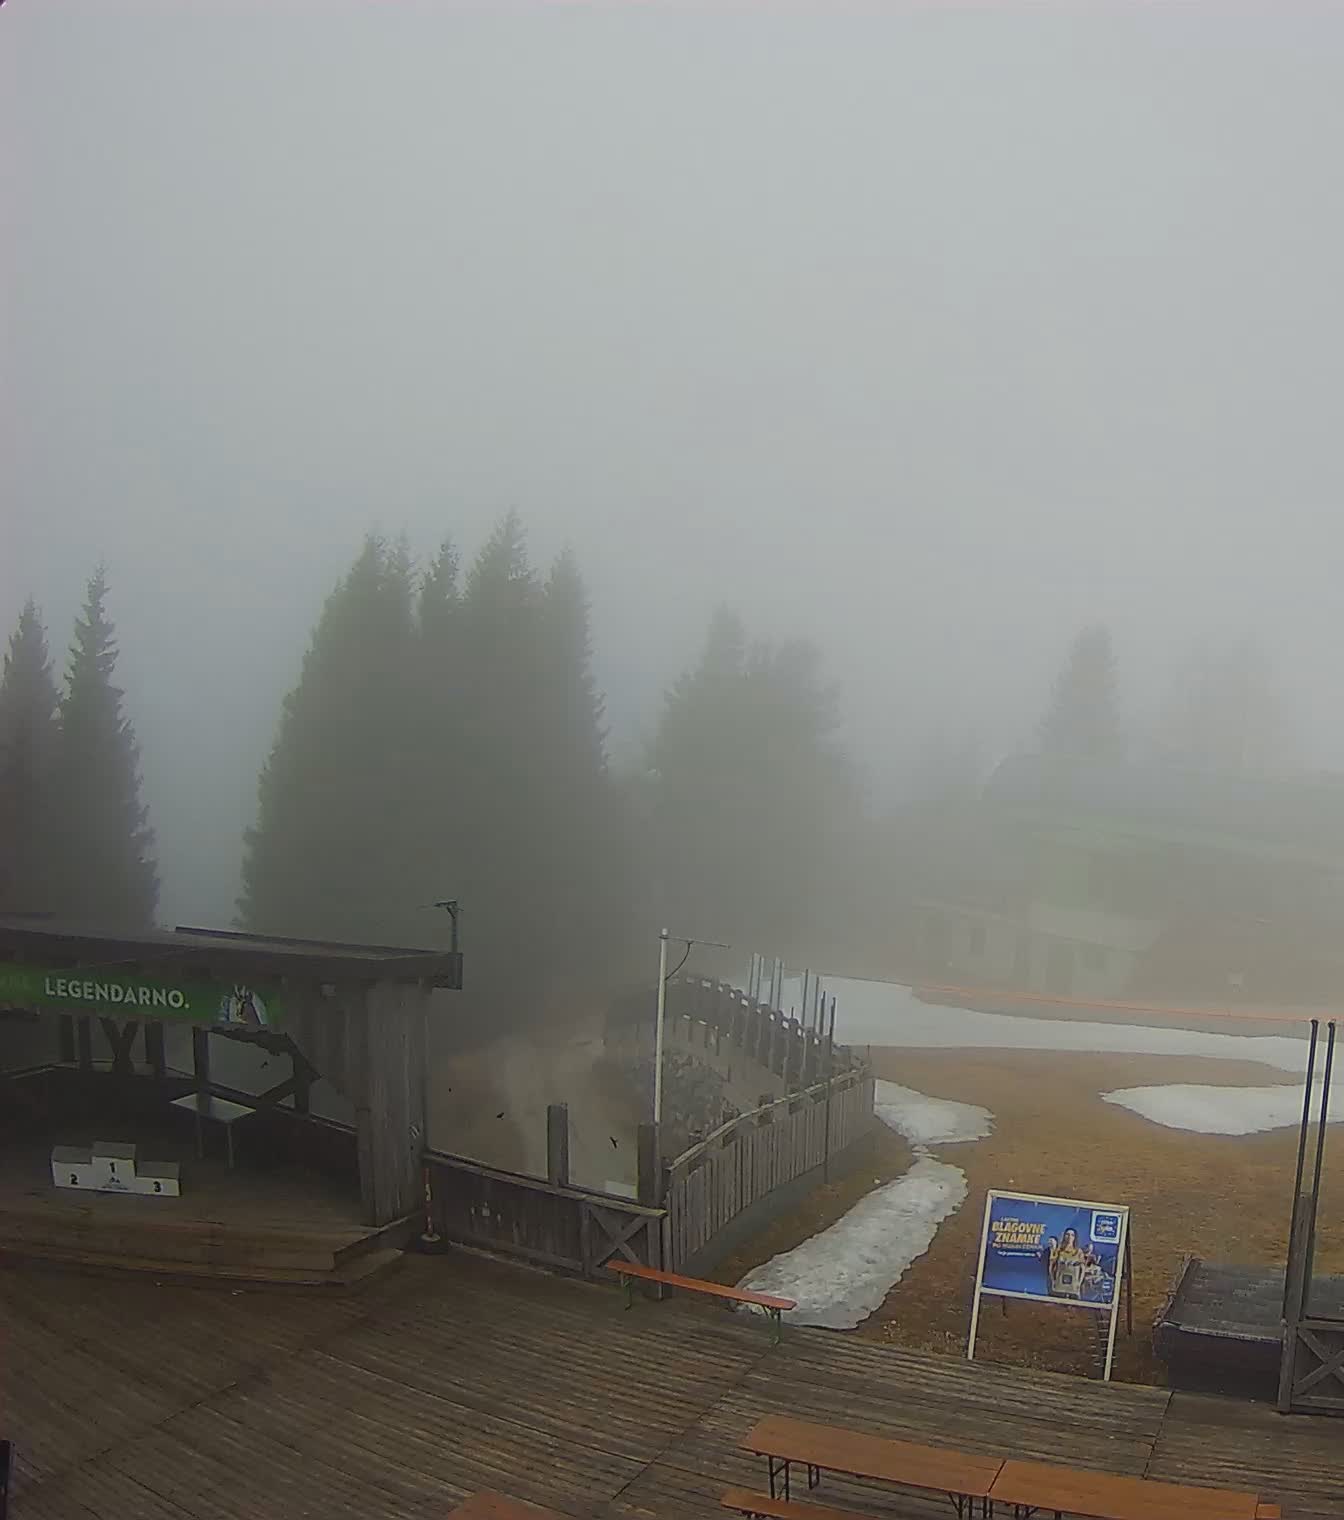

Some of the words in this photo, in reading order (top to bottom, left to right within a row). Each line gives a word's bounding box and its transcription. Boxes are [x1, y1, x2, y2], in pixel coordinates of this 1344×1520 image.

[44, 977, 190, 1009] LEGENDARNO.
[109, 1162, 116, 1173] 1
[70, 1173, 79, 1185] 2
[153, 1181, 162, 1193] 3
[992, 1221, 1046, 1235] BLAGOVNE
[994, 1232, 1041, 1244] ZNAMKE
